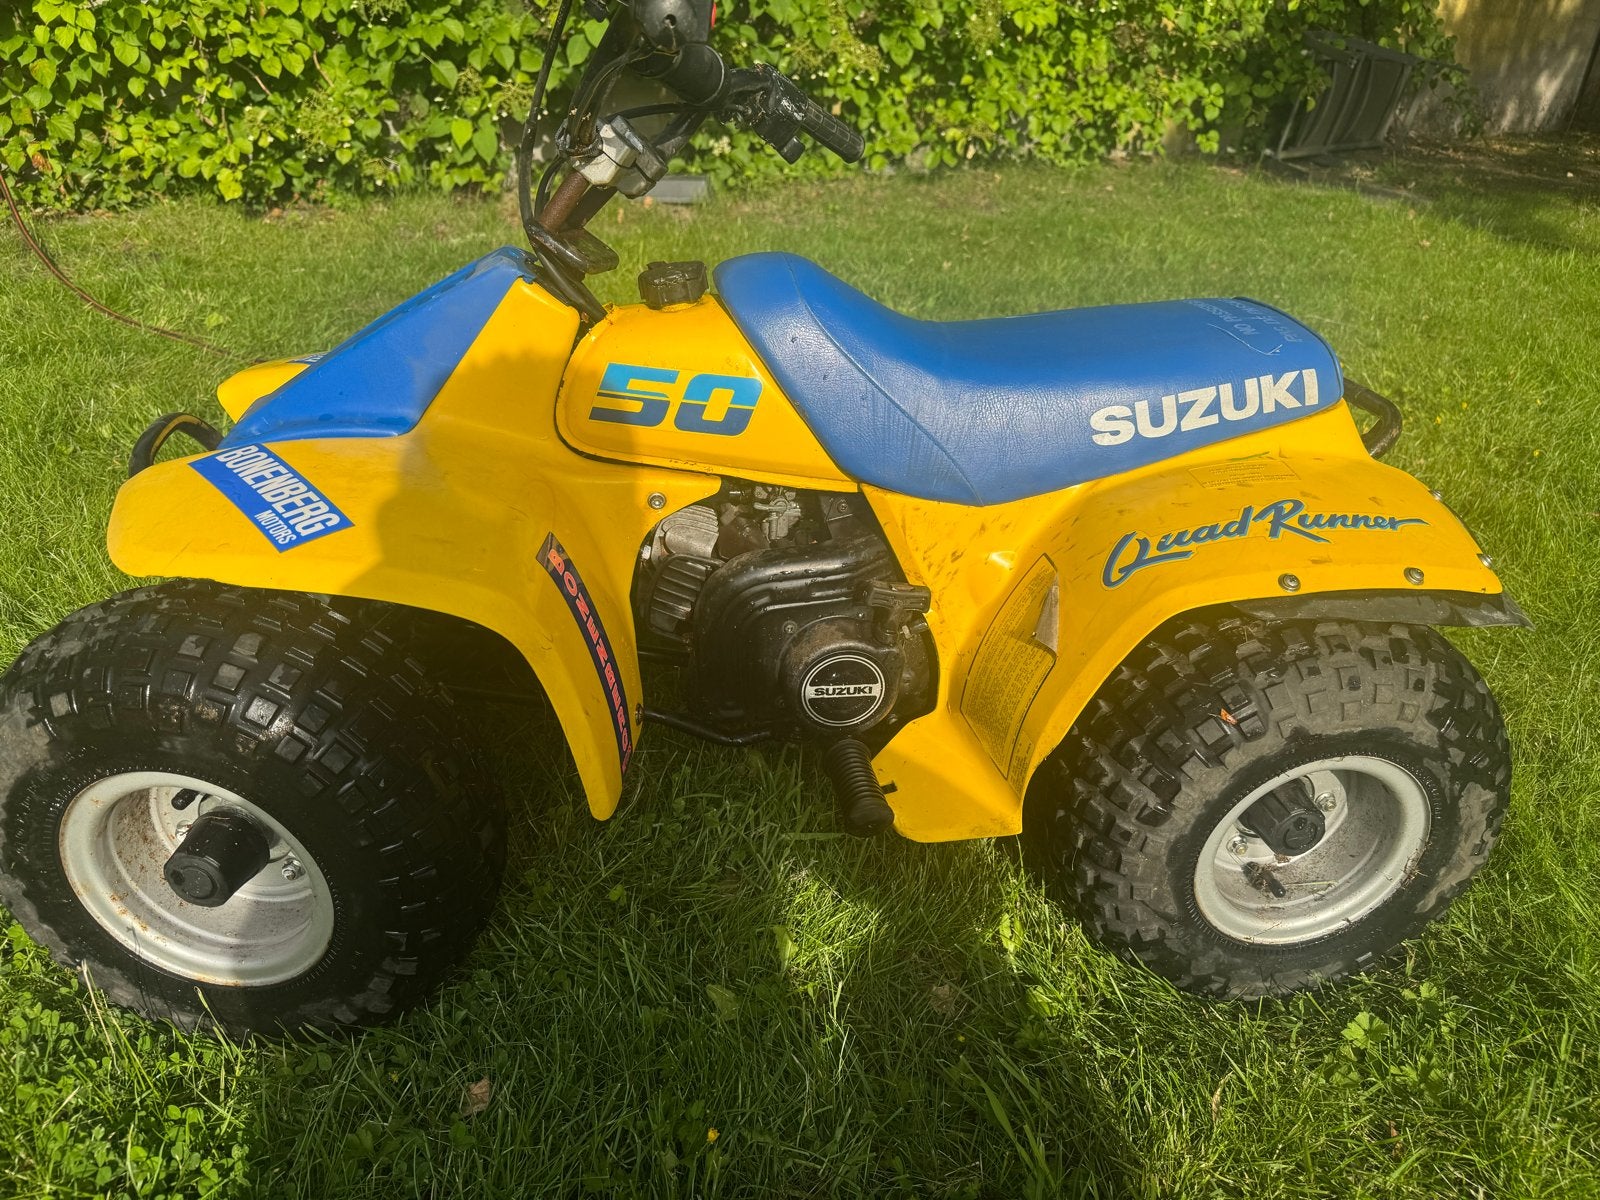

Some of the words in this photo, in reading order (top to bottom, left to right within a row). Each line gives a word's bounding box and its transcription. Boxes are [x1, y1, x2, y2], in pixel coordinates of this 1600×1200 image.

[588, 362, 763, 437] 50
[1089, 368, 1320, 446] SUZUKI
[215, 445, 341, 537] BONENBERG
[254, 509, 297, 545] MOTORS
[1102, 505, 1253, 588] Quad
[1250, 498, 1430, 544] Runner
[814, 686, 873, 697] SUZUKI
